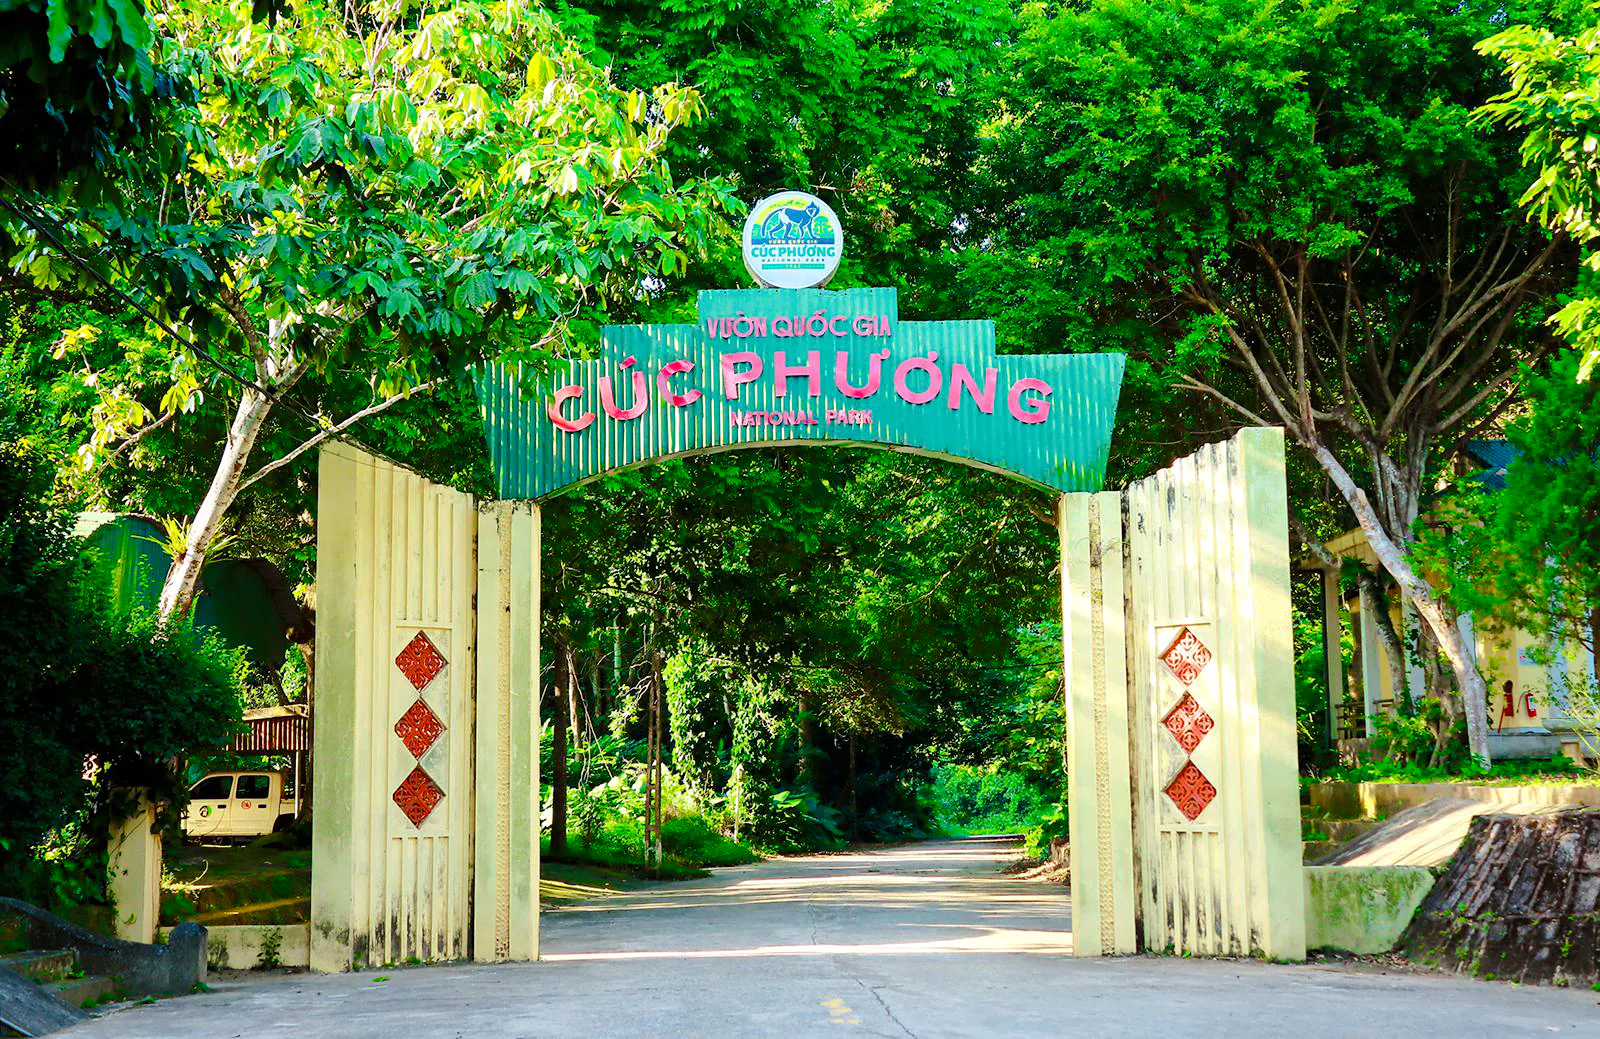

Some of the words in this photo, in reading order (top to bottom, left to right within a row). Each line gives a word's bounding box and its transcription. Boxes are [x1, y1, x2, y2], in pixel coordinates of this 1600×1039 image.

[751, 244, 777, 257] CÚC
[778, 245, 835, 257] PHƯƠNG
[707, 311, 767, 338] VƯỜN
[771, 310, 847, 338] QUỐC
[852, 315, 891, 337] GIA
[548, 354, 702, 433] CÚC
[721, 348, 1053, 424] PHƯƠNG
[731, 410, 818, 426] NATIONAL
[826, 409, 873, 425] PARK
